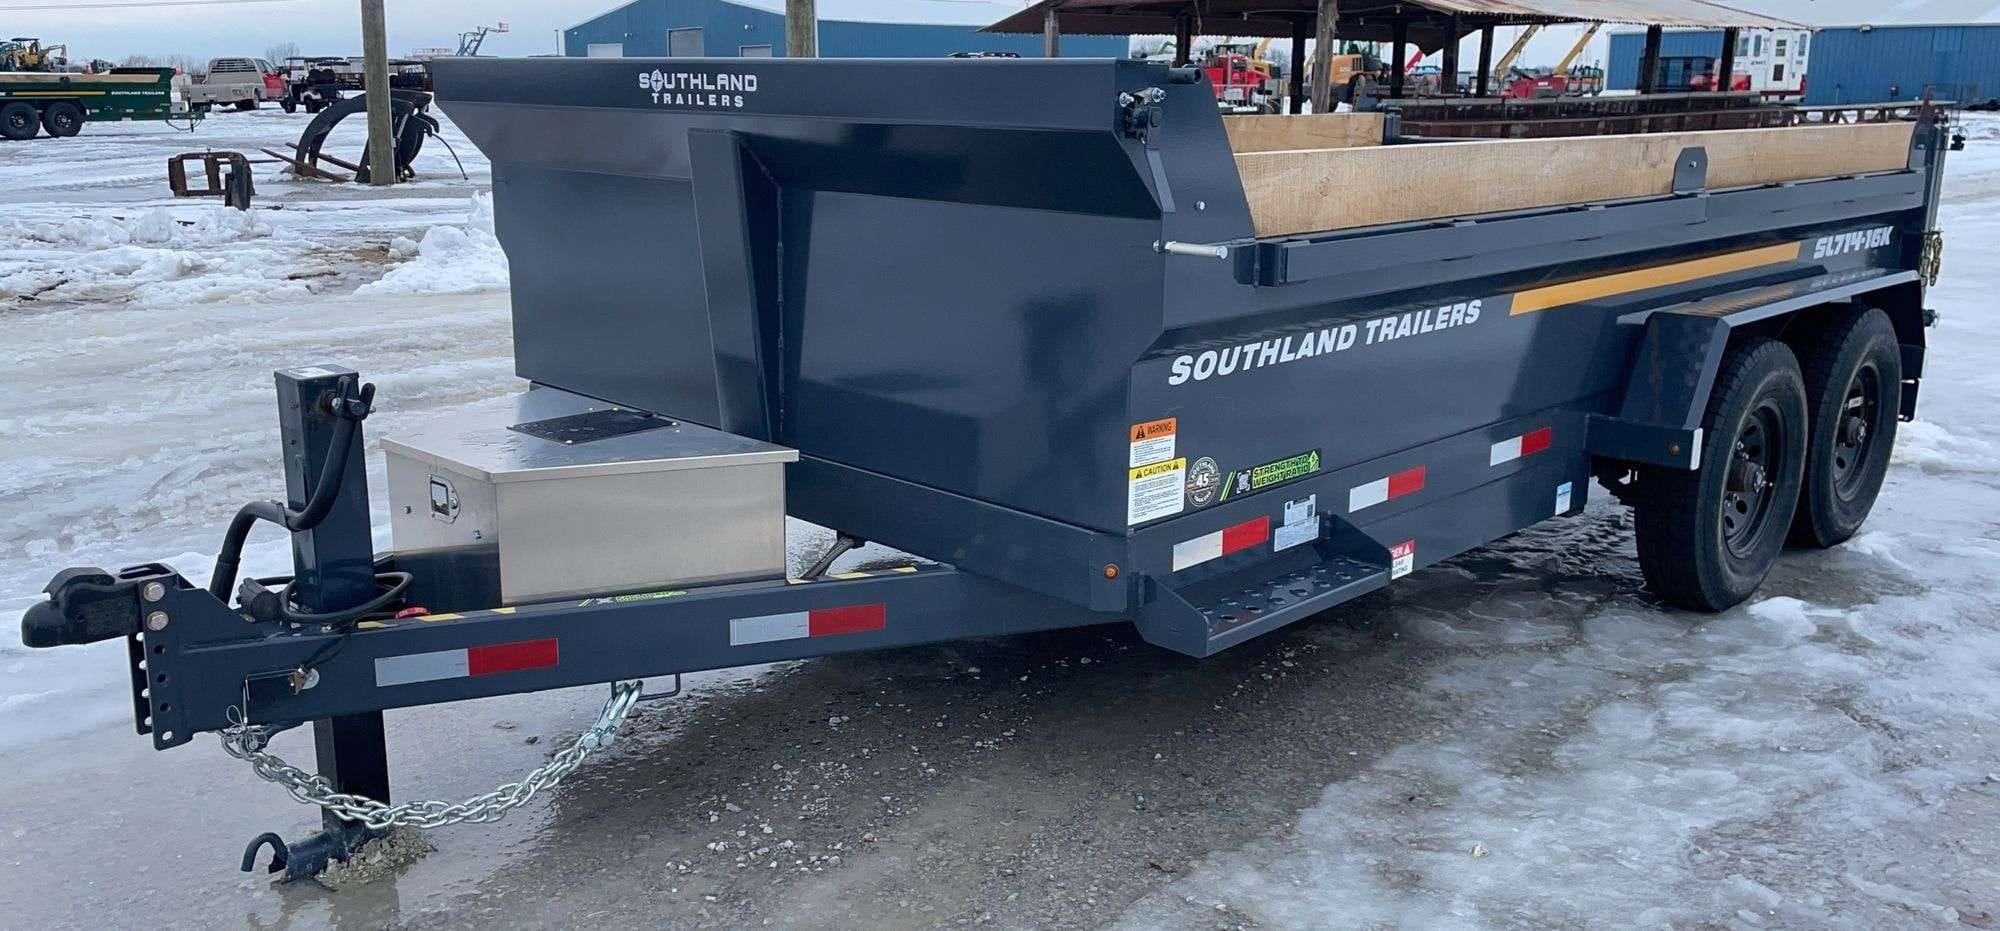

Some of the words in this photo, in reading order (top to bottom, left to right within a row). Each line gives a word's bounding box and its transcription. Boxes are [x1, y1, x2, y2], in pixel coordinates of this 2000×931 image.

[639, 69, 757, 92] SOUTHLAND
[651, 93, 744, 107] TRAILERS
[1813, 226, 1894, 259] SL714-16K
[1168, 324, 1357, 386] SOUTHLAND
[1365, 299, 1482, 345] TRAILERS
[1147, 422, 1171, 435] WARNING
[1143, 463, 1171, 477] CAUTION
[1285, 464, 1309, 477] RATIO
[1196, 472, 1210, 487] 45
